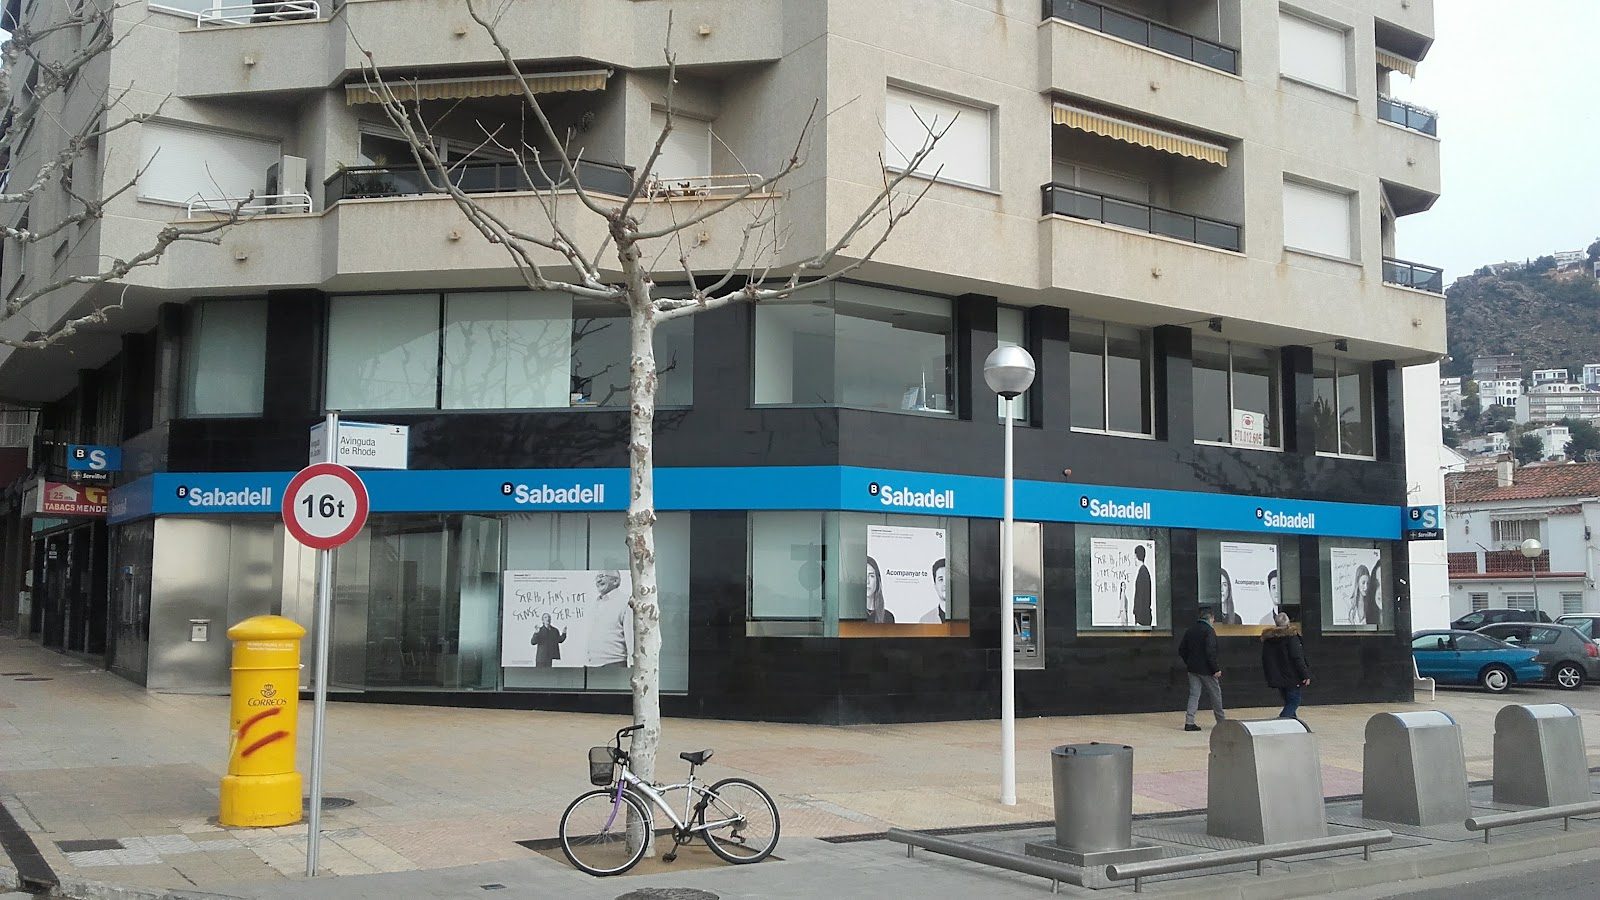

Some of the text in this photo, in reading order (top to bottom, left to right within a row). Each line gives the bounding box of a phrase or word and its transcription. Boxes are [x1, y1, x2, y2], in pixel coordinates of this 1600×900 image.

[340, 436, 376, 447] Avinguda
[340, 446, 376, 456] de Rhode
[89, 449, 107, 470] S
[53, 492, 64, 500] 25
[188, 487, 272, 506] Sabadell
[514, 483, 605, 504] Sabadell
[880, 485, 954, 509] Sabadell
[44, 502, 75, 512] TABACS
[1089, 498, 1151, 520] Sabadell
[1263, 510, 1315, 529] Sabadell
[1422, 509, 1437, 529] S
[247, 697, 288, 707] CORREOS
